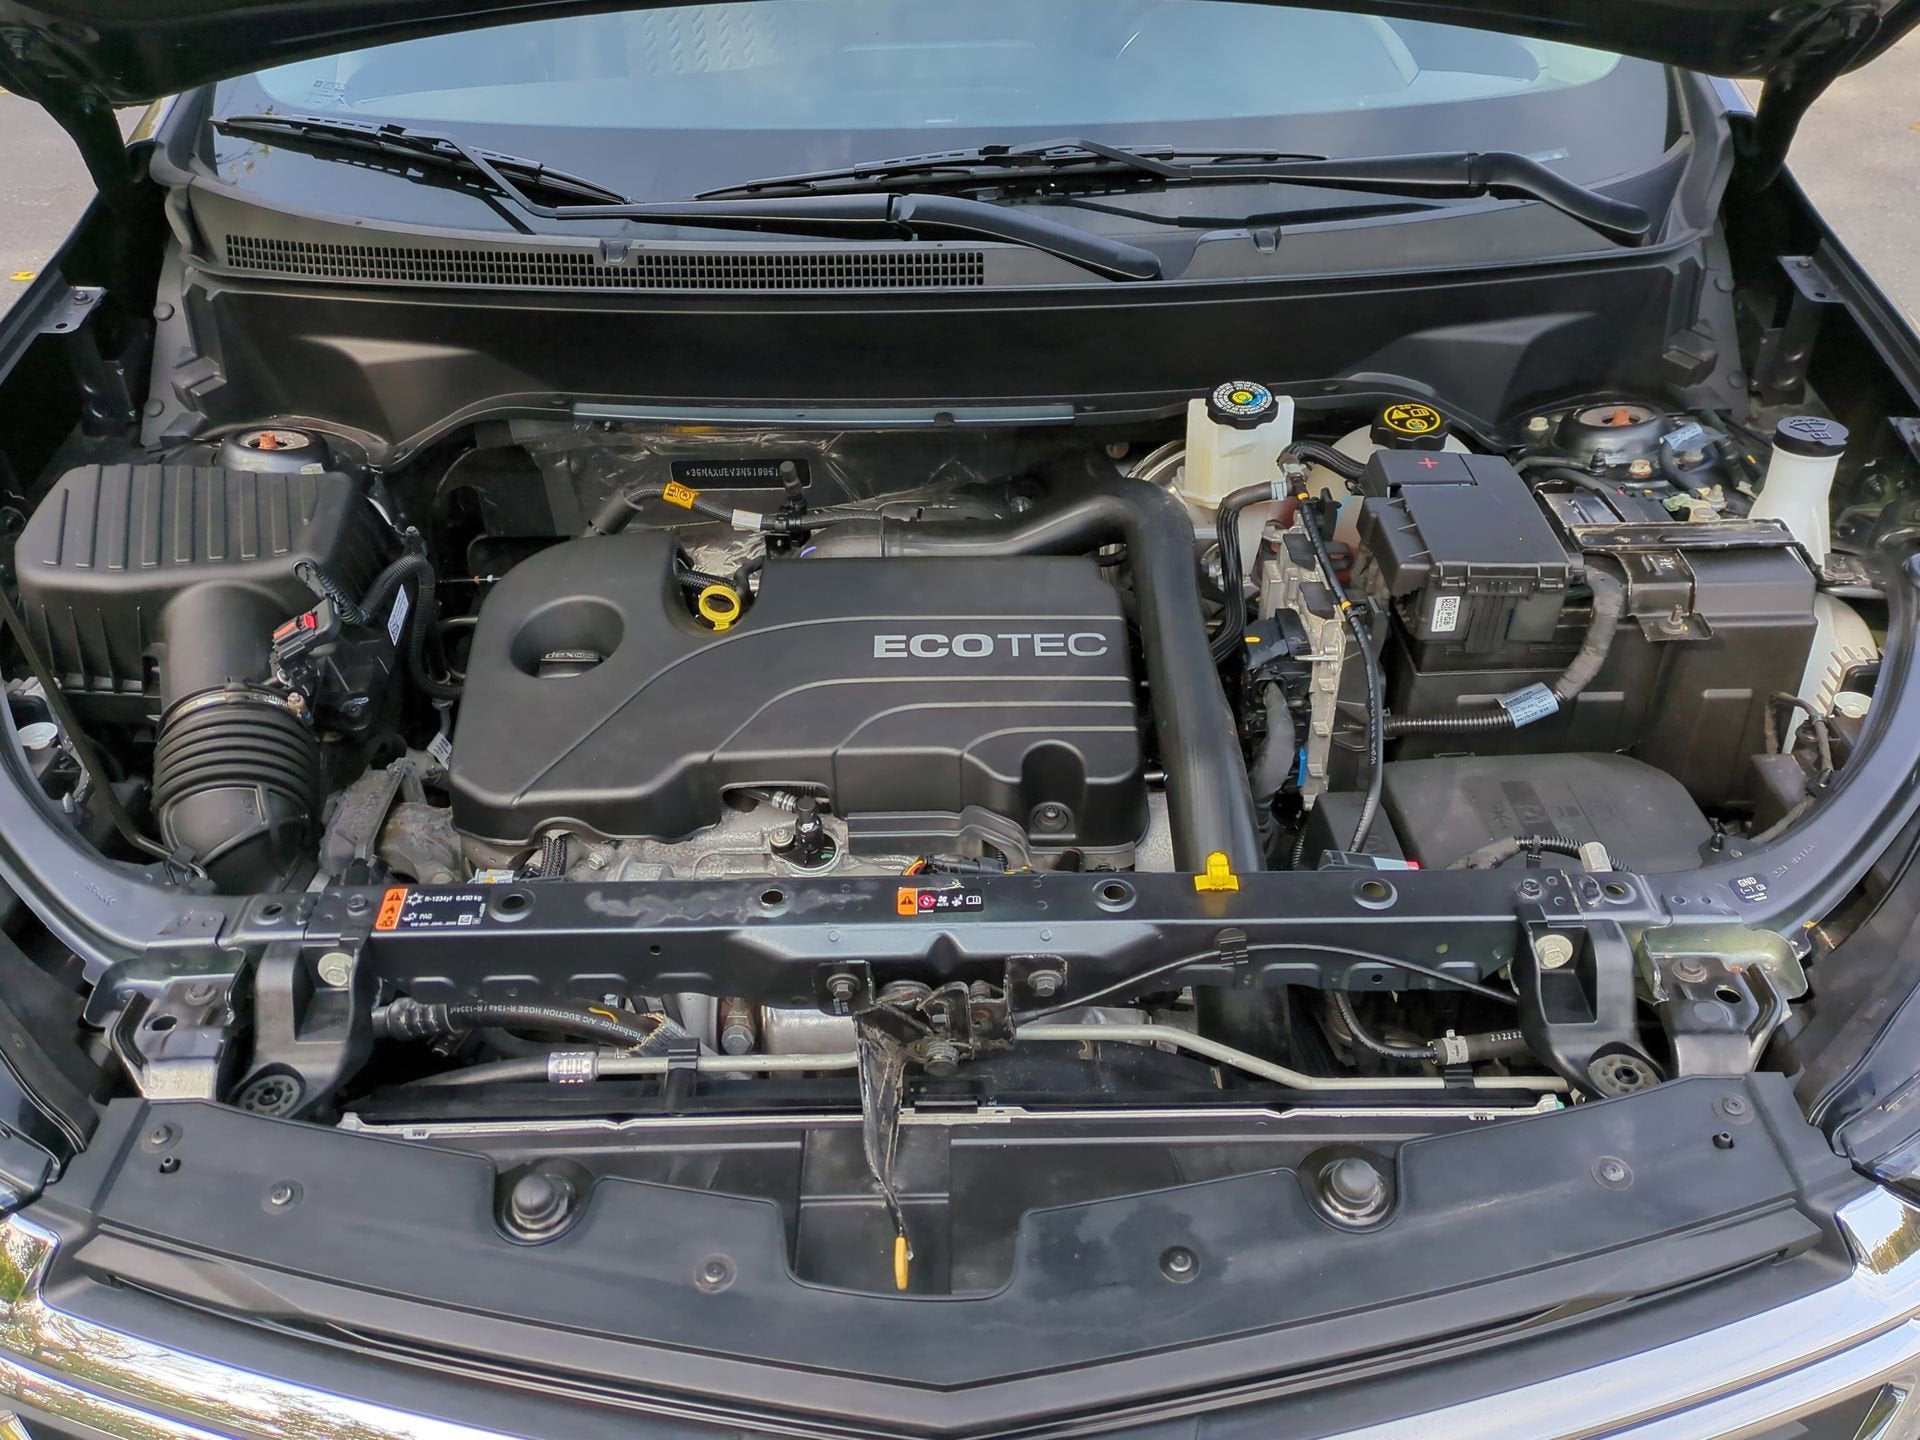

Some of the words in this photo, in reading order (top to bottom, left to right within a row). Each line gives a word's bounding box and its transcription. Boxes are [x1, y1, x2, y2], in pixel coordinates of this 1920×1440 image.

[874, 632, 1108, 658] ECOTEC
[1737, 877, 1756, 887] GND
[518, 1005, 541, 1014] HOSE
[543, 1008, 581, 1022] SUCTION
